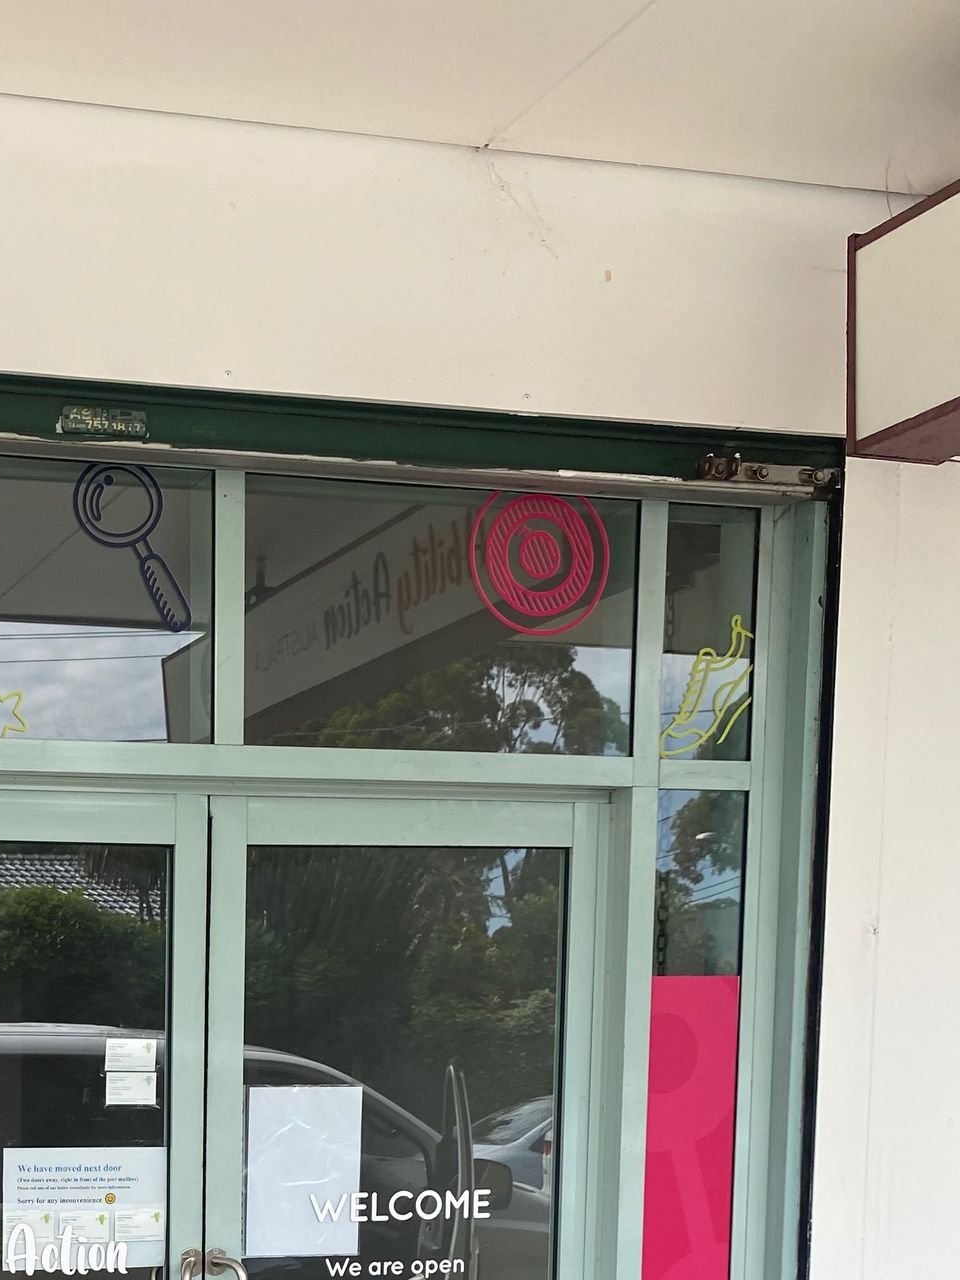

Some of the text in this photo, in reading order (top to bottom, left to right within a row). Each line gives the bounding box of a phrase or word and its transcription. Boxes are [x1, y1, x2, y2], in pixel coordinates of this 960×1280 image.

[17, 1164, 31, 1172] We
[34, 1164, 52, 1172] have
[55, 1164, 81, 1172] moved
[103, 1164, 122, 1172] door
[310, 1189, 491, 1223] WELCOME
[6, 1223, 128, 1276] Action
[325, 1258, 465, 1279] We are open
